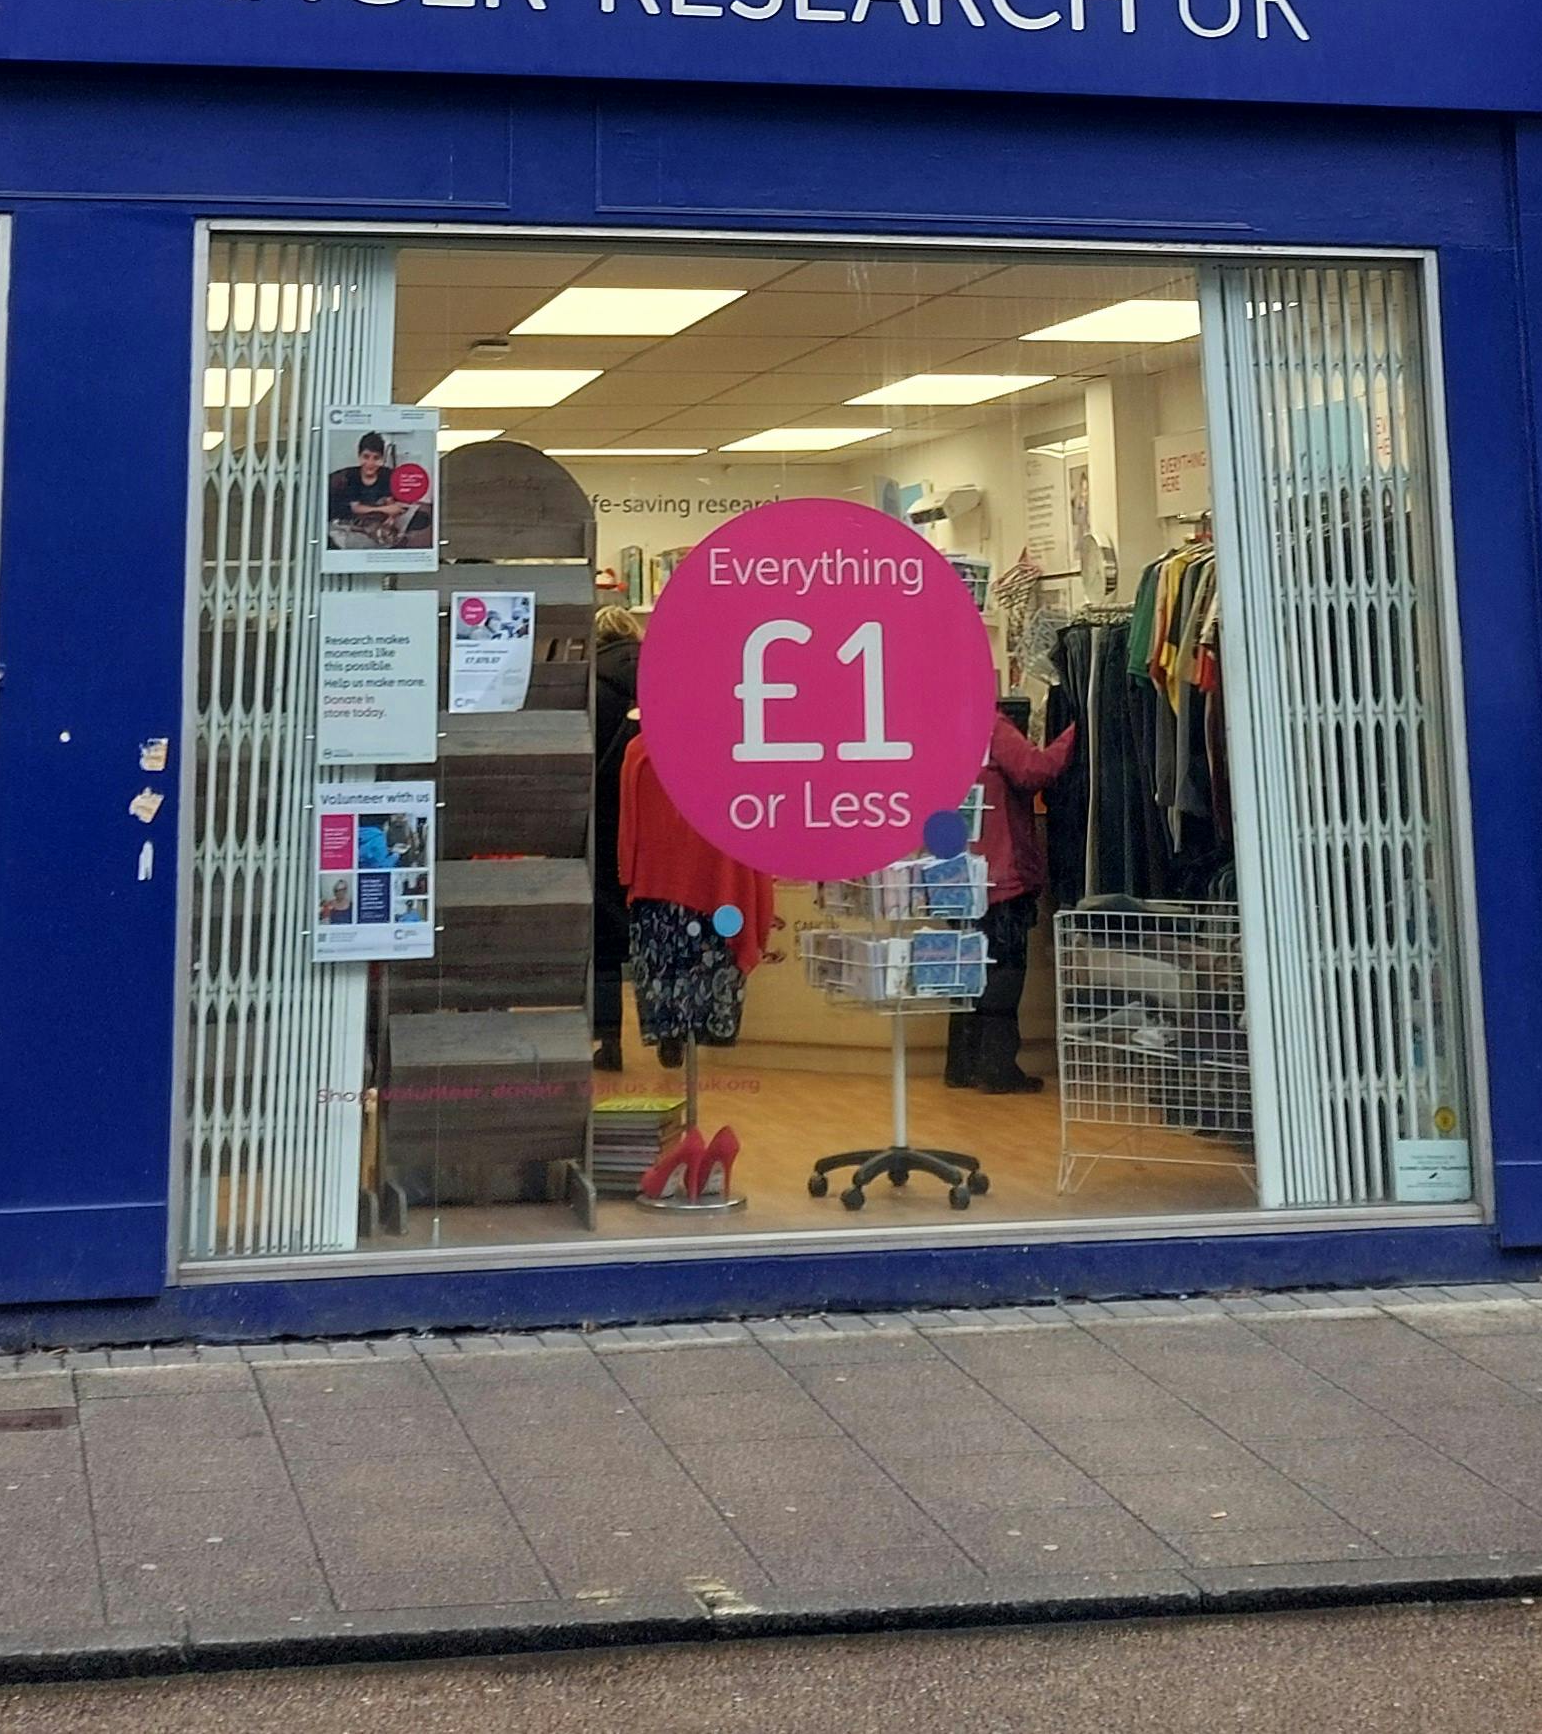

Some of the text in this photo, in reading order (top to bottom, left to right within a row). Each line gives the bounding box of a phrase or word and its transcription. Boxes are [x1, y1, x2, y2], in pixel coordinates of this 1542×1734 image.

[590, 493, 780, 518] fe-saving resear
[709, 547, 924, 596] Everything
[324, 634, 411, 646] Research makes
[323, 647, 396, 659] moments like
[323, 661, 343, 672] this
[323, 678, 351, 689] Help
[352, 679, 364, 688] us
[365, 677, 396, 688] make
[731, 618, 914, 763] £1
[323, 694, 375, 705] Donate in
[323, 709, 351, 719] store
[320, 791, 430, 806] Volunteer with us
[729, 780, 912, 830] or Less
